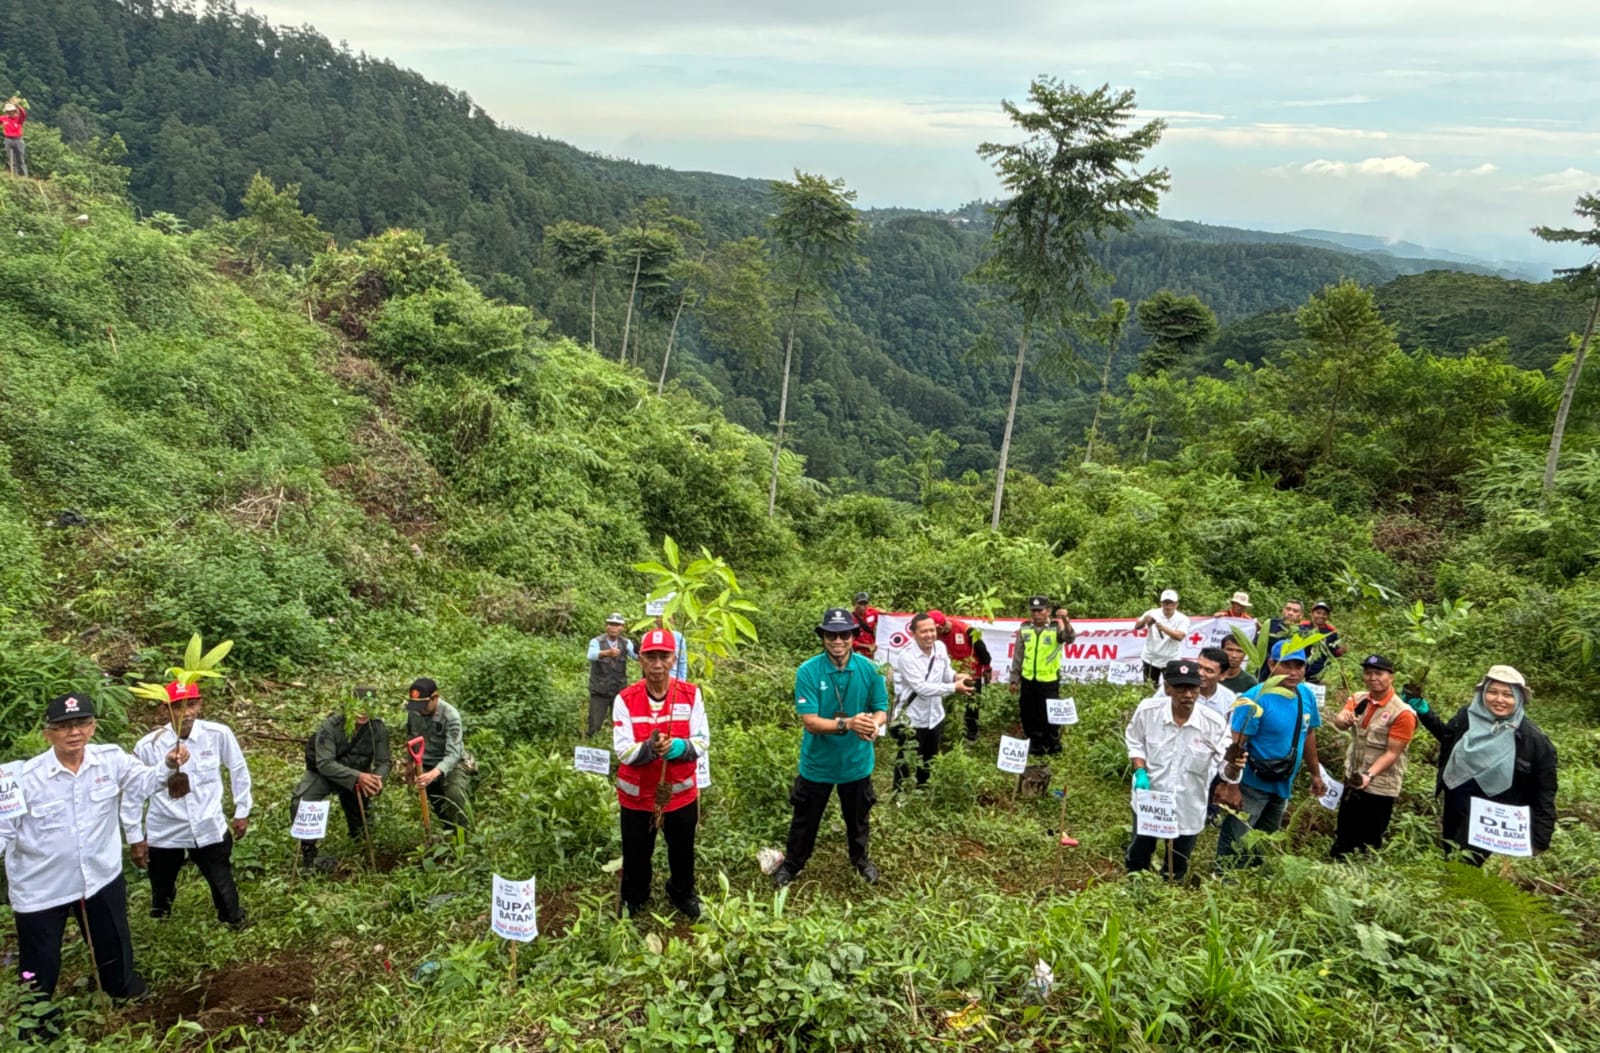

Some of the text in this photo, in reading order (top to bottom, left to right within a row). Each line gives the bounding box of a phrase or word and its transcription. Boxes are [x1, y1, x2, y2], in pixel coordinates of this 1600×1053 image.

[1064, 644, 1118, 660] WAN
[1002, 746, 1025, 758] CAM
[0, 781, 19, 793] UA
[1139, 803, 1169, 816] WAKIL
[297, 812, 324, 823] HUTANI
[495, 895, 534, 913] BUPA
